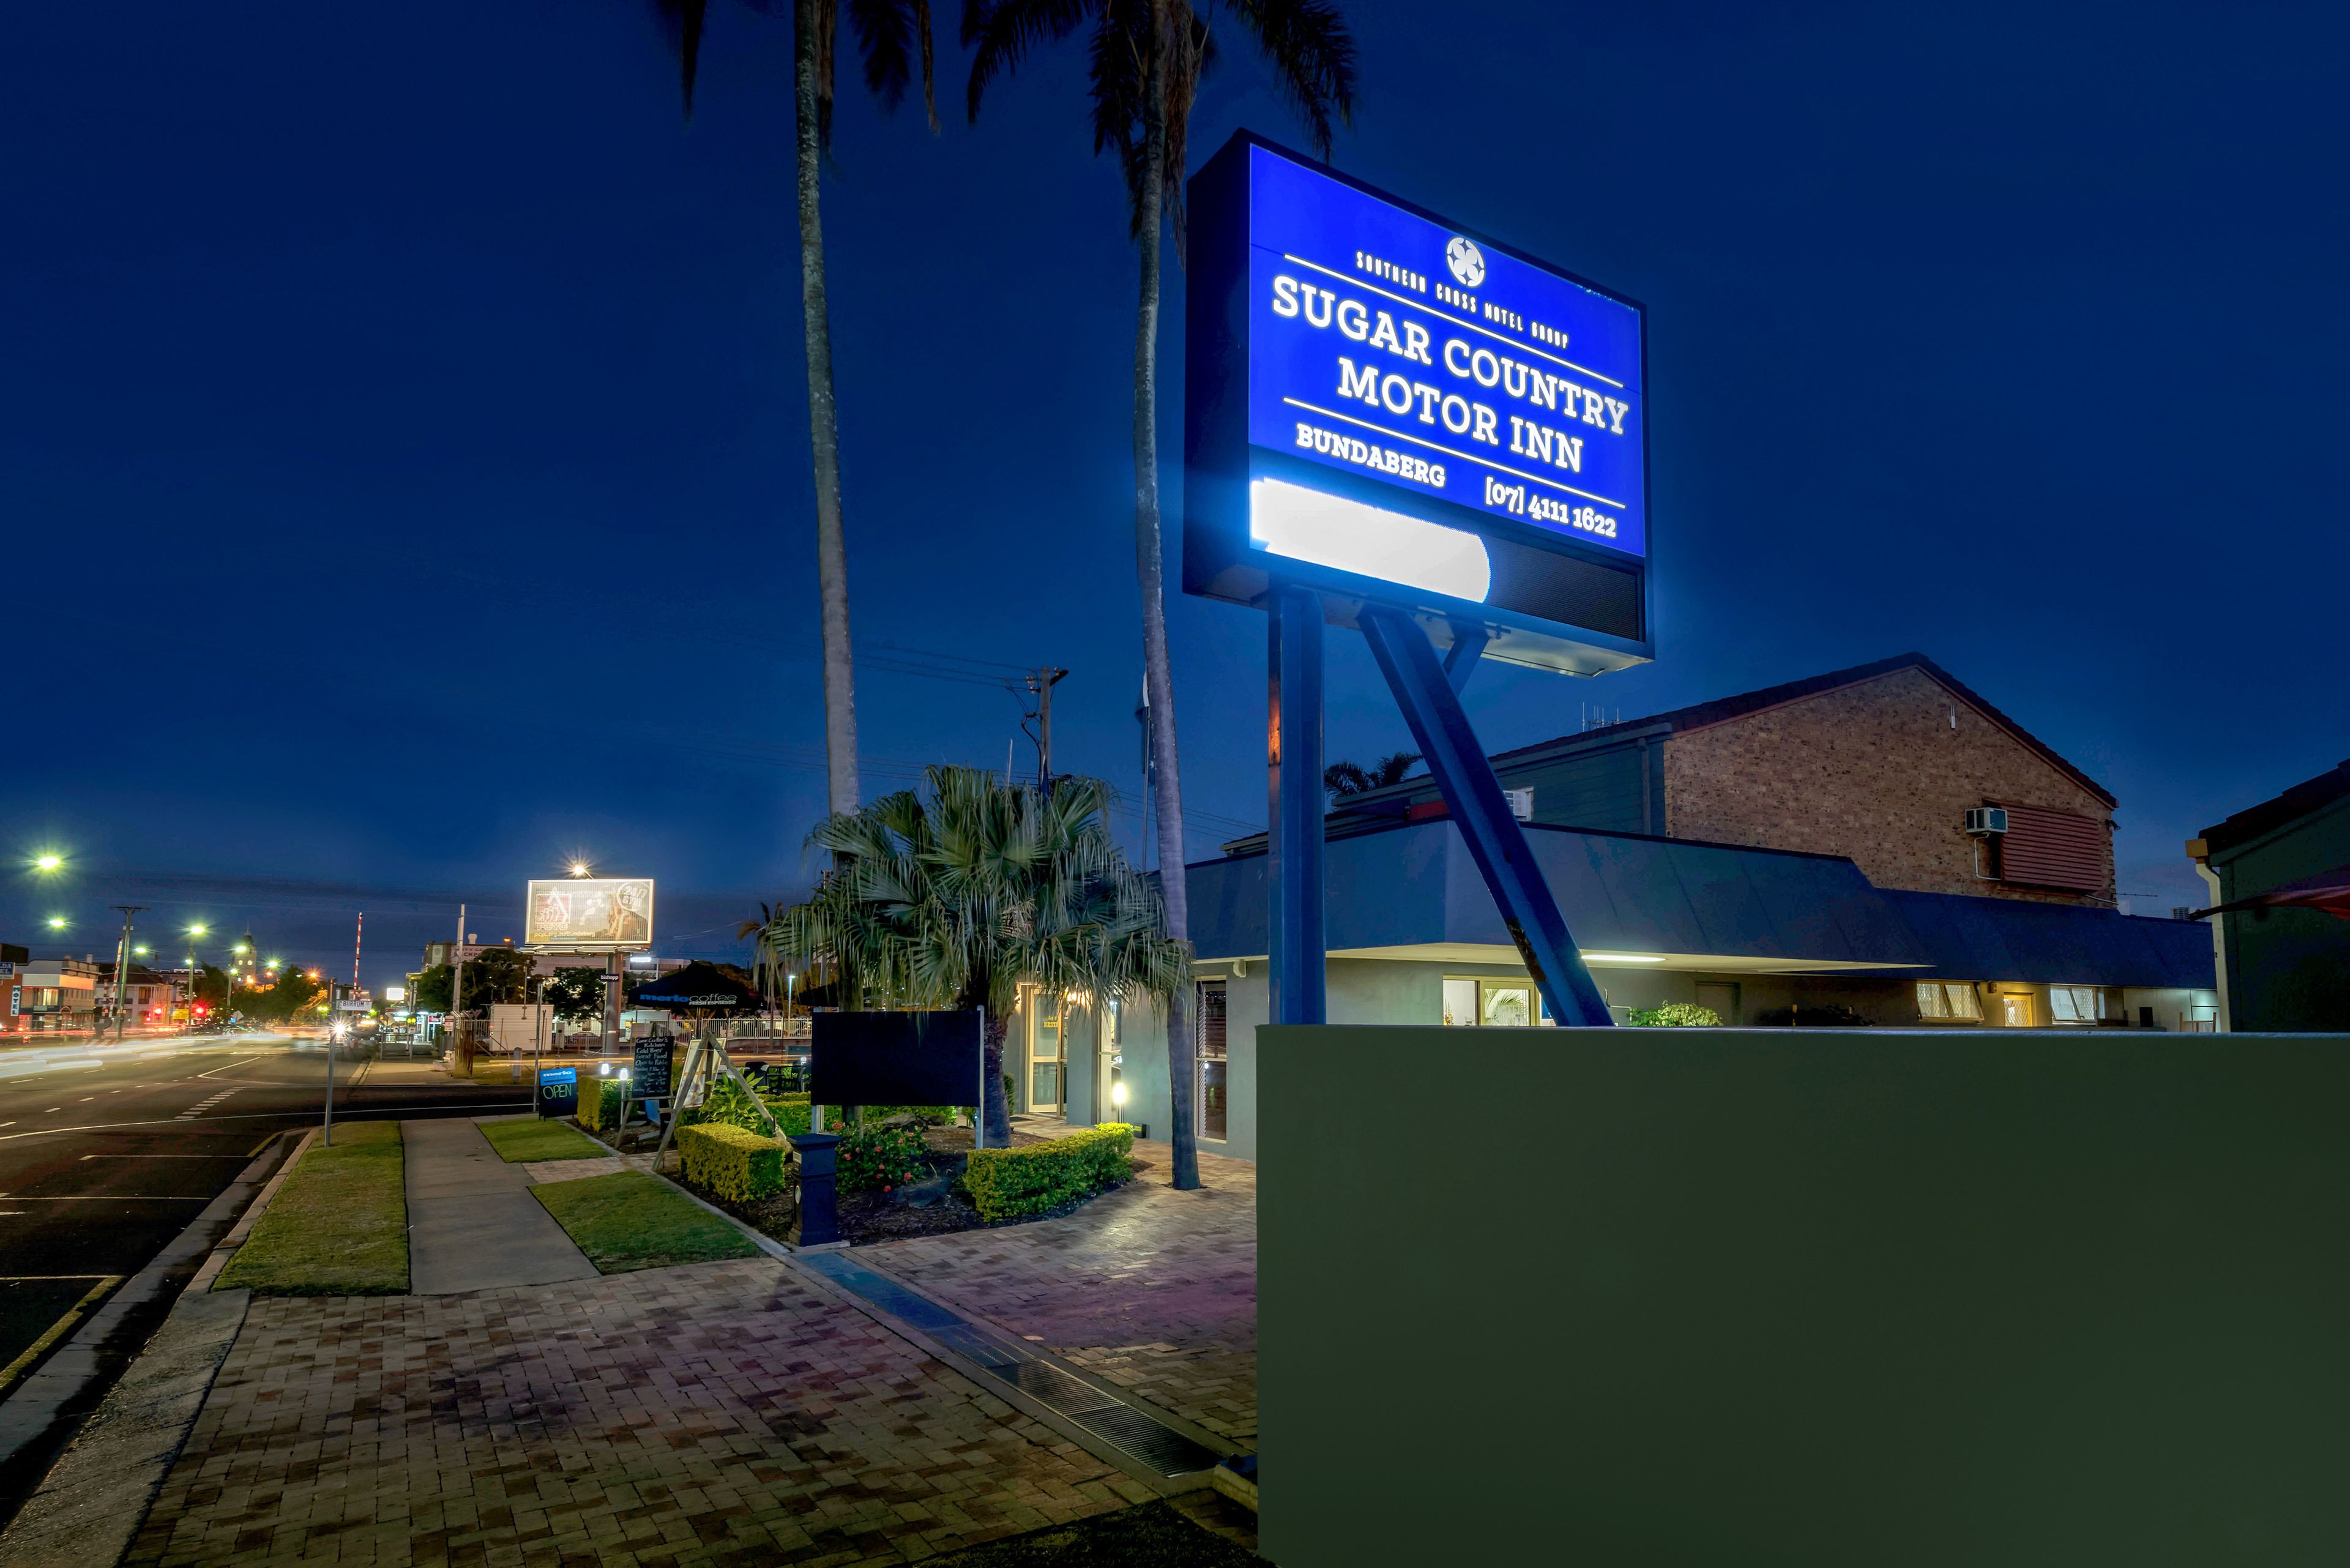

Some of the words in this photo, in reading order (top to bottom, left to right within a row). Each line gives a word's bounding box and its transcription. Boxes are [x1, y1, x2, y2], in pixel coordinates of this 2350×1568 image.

[1356, 251, 1427, 293] SOUTHERN
[1436, 283, 1477, 313] CROSS
[1531, 321, 1568, 349] GROUP
[1272, 275, 1432, 365] SUGAR
[1444, 338, 1629, 435] COUNTRY
[1296, 422, 1446, 488] BUNDABERG
[1337, 356, 1499, 446] MOTOR
[1509, 415, 1584, 473] INN
[1485, 476, 1525, 515] [07]
[1527, 494, 1570, 525] 4111
[1572, 507, 1617, 539] 1622
[543, 1083, 572, 1099] OPEN
